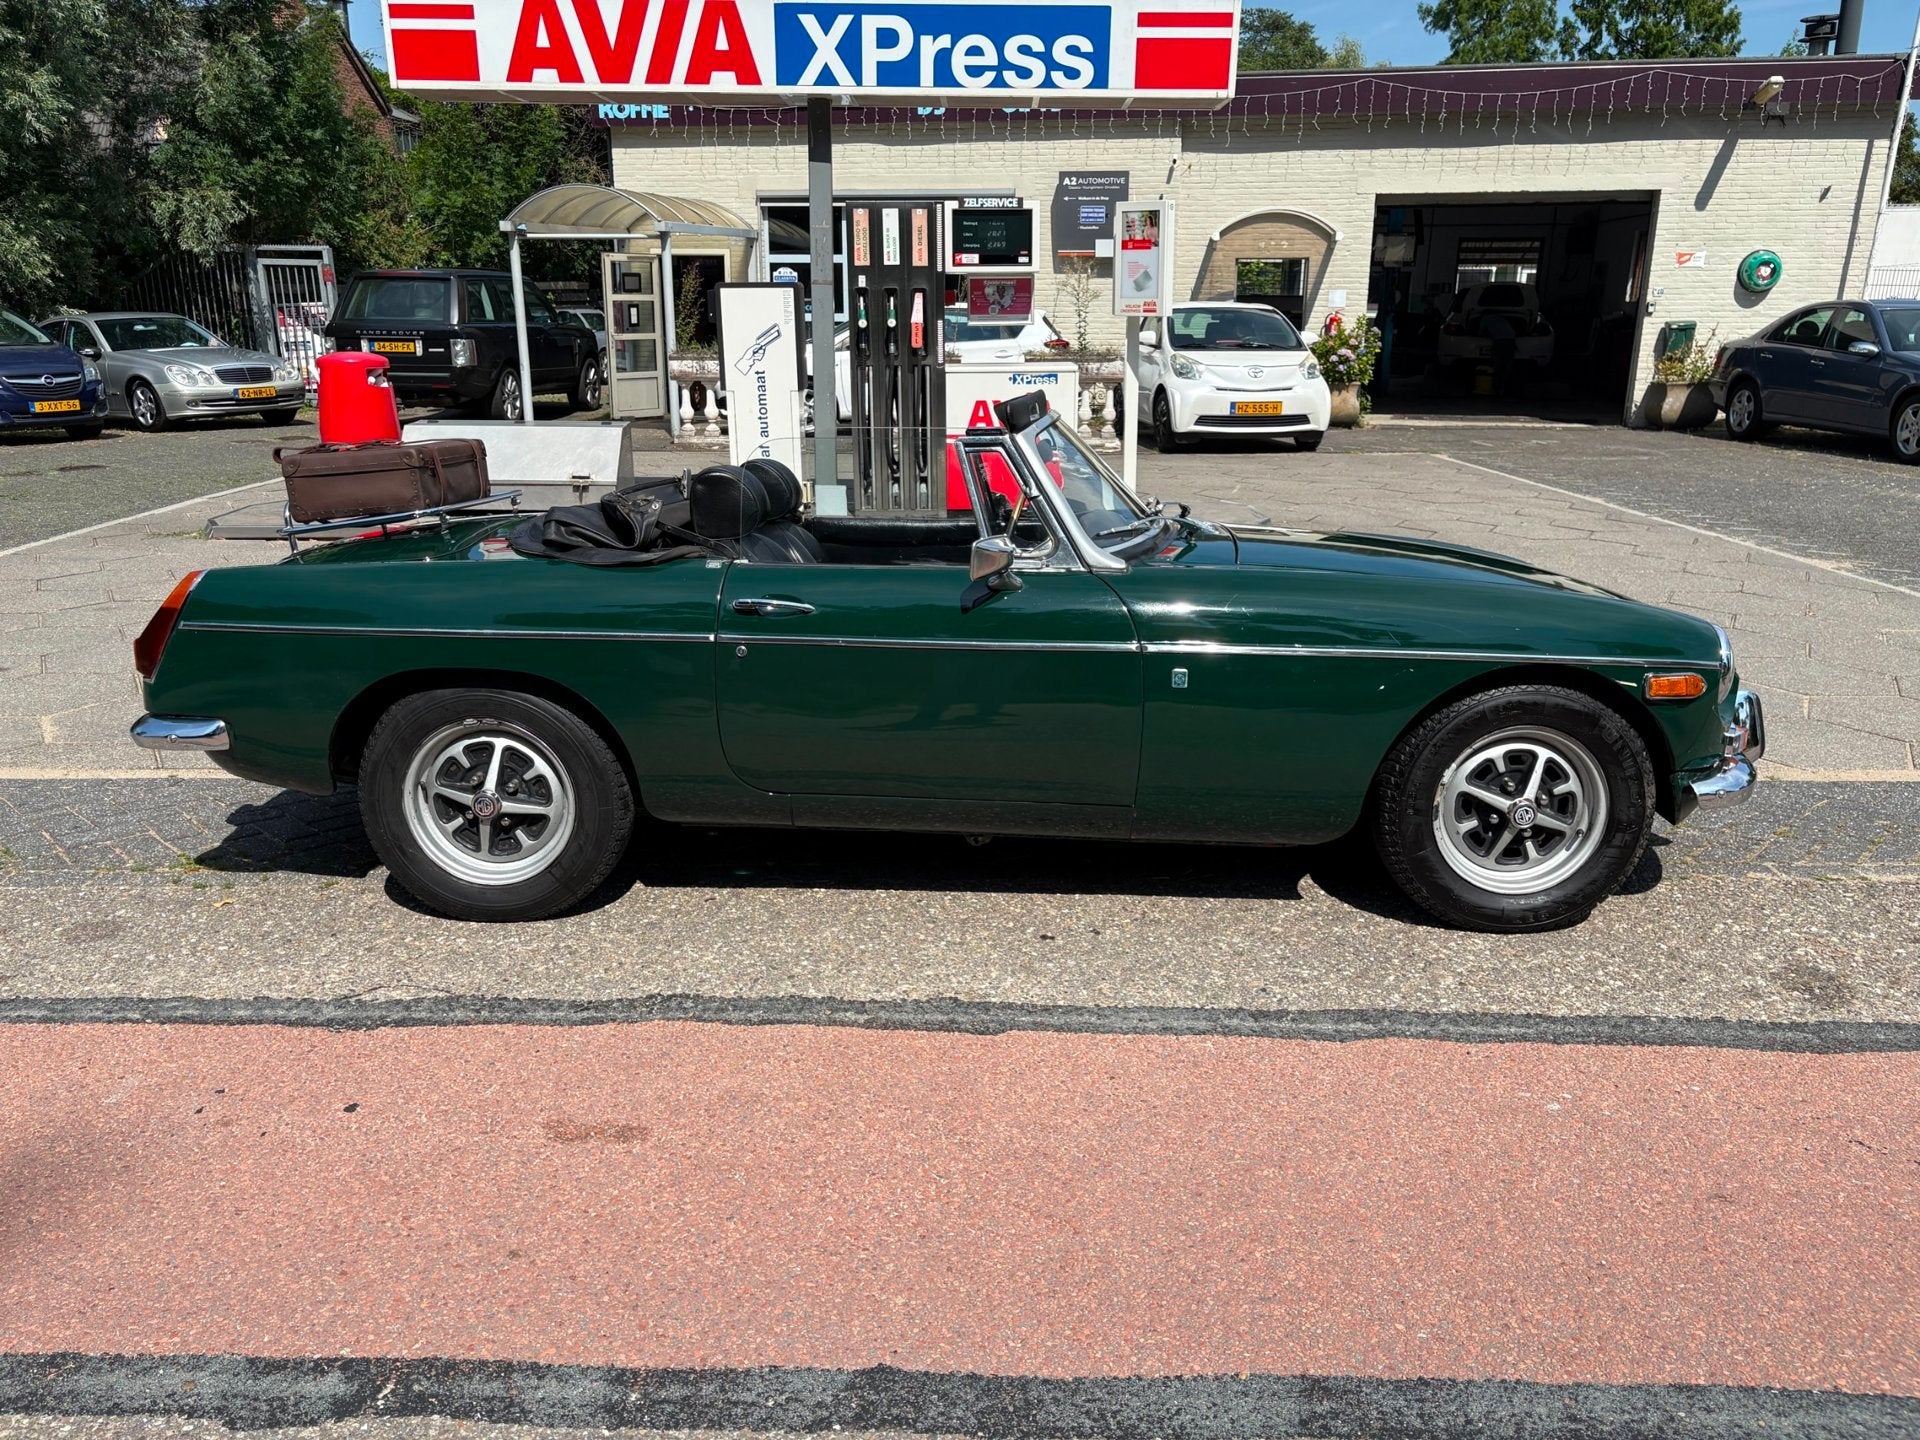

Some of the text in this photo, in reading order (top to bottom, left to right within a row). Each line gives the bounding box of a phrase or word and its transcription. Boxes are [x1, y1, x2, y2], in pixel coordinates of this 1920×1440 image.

[506, 0, 1095, 89] AVIA XPress
[1063, 176, 1126, 185] A2 AUTOMOTIVE
[963, 197, 1018, 207] ZELFSERVICE
[1014, 374, 1056, 385] XPress
[755, 370, 770, 438] automaat
[1237, 404, 1279, 413] HZ-555-H
